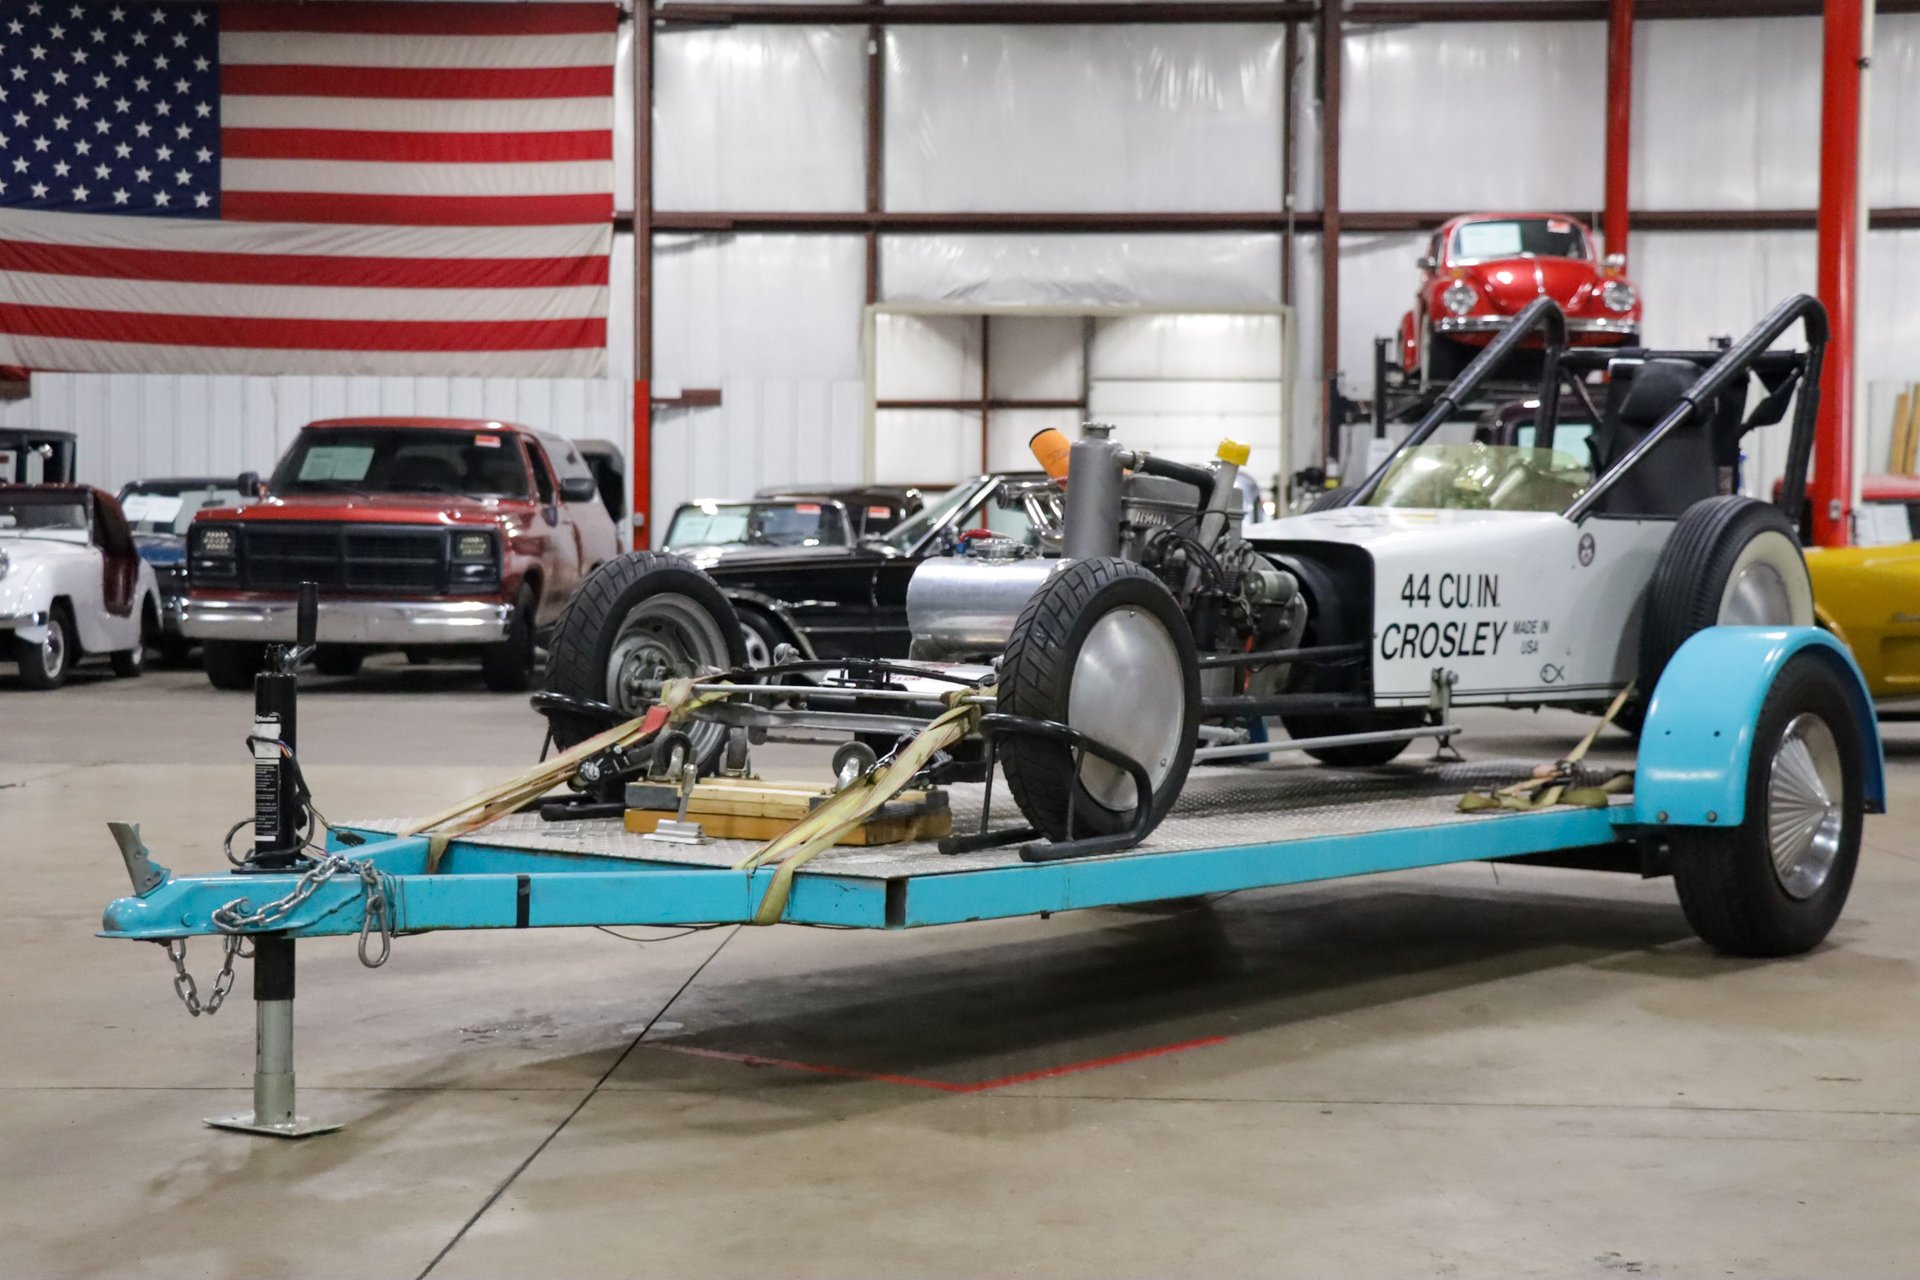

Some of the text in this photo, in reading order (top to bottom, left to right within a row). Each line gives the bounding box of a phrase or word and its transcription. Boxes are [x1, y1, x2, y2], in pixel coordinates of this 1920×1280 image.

[1401, 573, 1431, 608] 44
[1513, 619, 1550, 634] MADE IN
[1381, 621, 1508, 661] CROSLEY
[1521, 639, 1539, 655] USA
